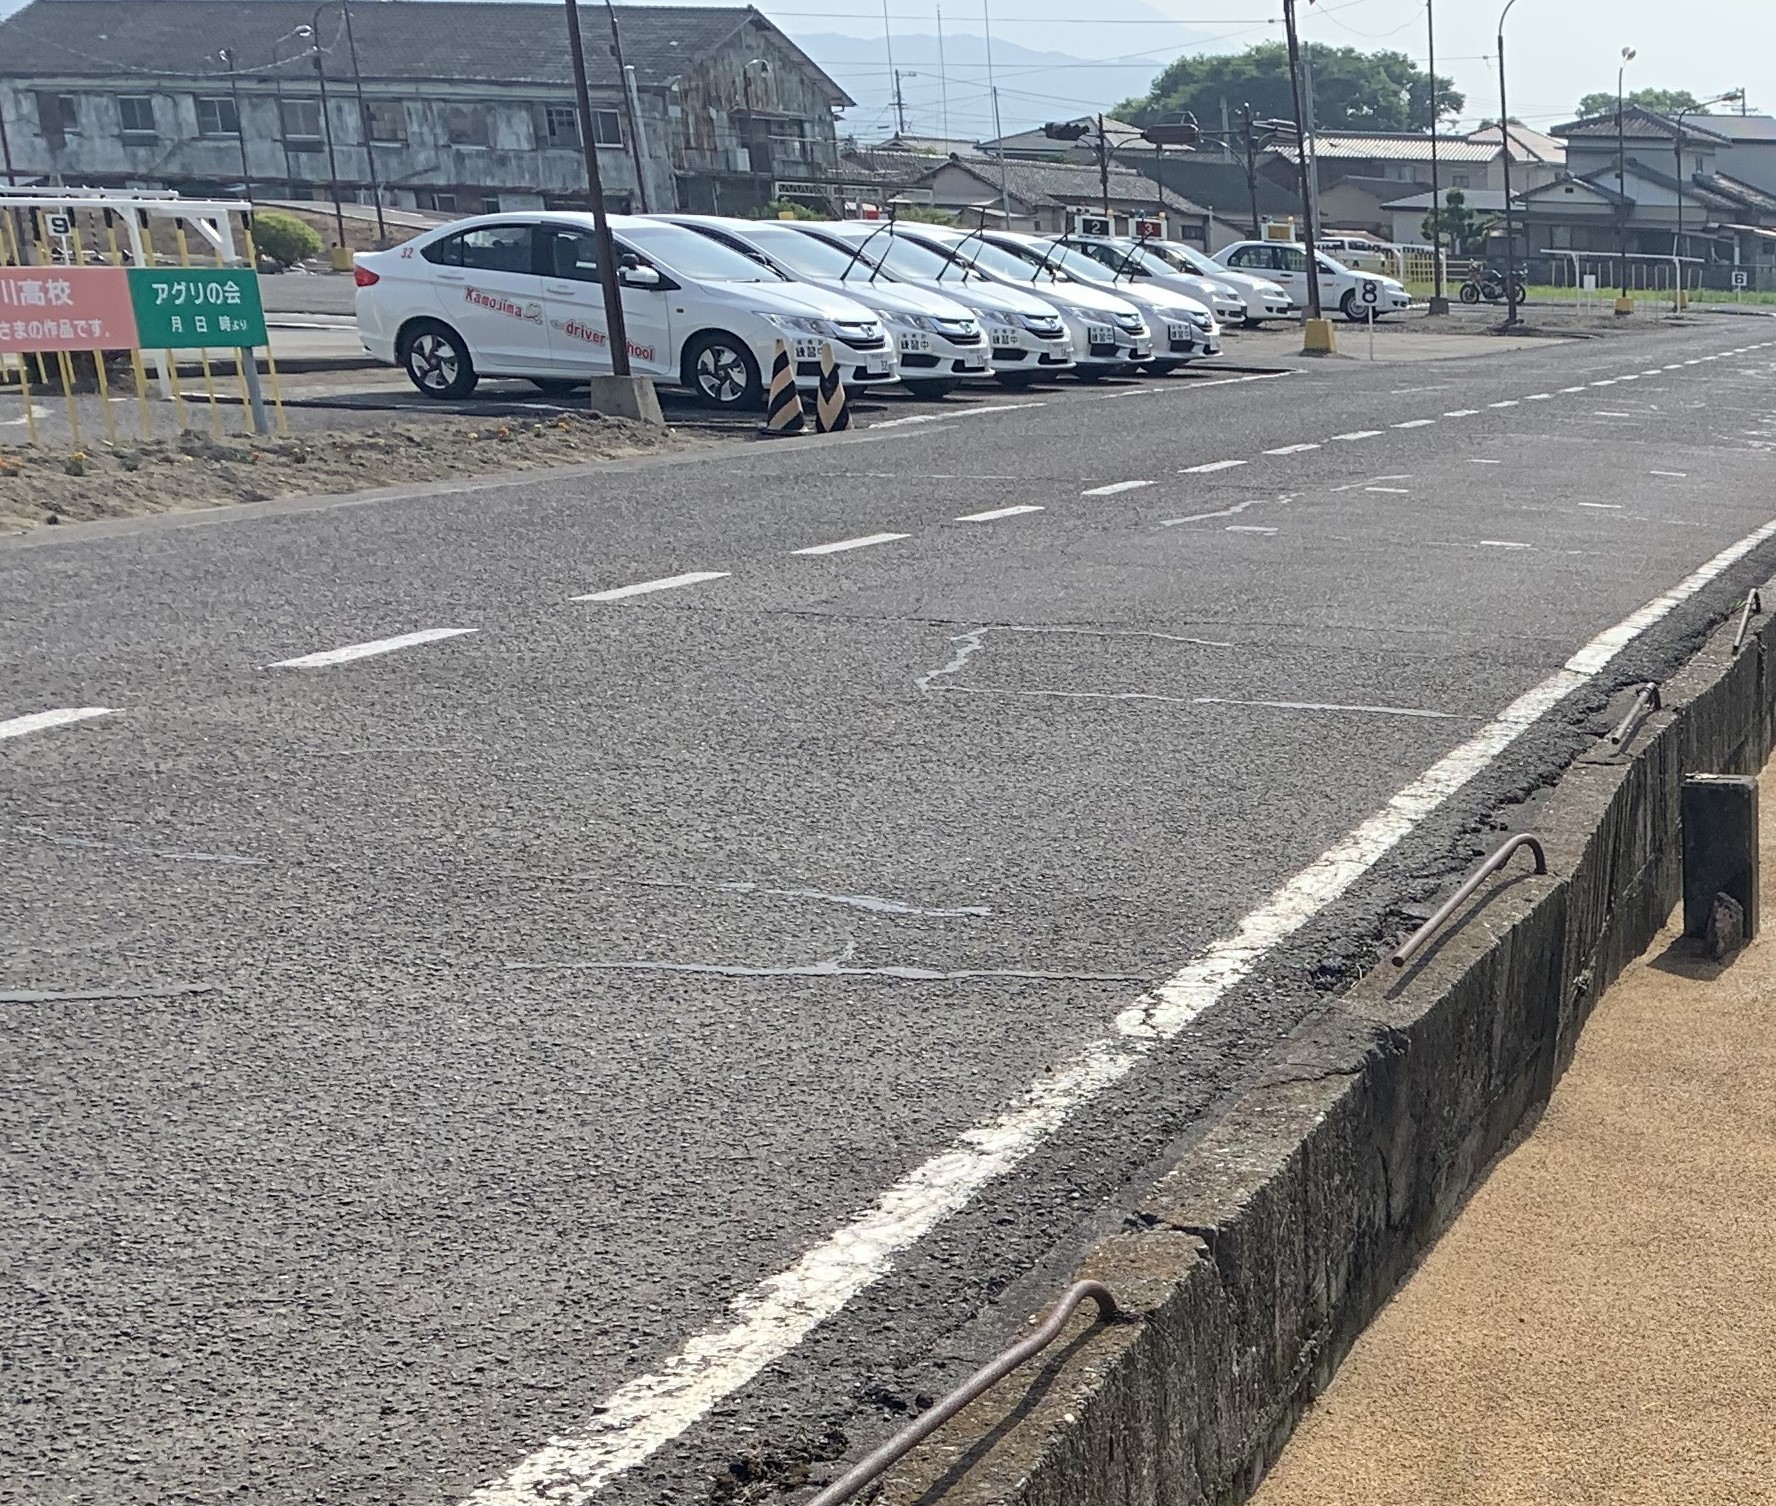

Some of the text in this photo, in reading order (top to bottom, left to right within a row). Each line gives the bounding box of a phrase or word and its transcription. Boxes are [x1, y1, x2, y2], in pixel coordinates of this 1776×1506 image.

[52, 217, 70, 234] 9
[1092, 221, 1100, 234] 2
[1145, 223, 1153, 235] 3
[401, 247, 414, 258] 32
[1735, 273, 1744, 284] 6
[152, 281, 241, 304] アグリの会
[1362, 281, 1377, 303] 8
[171, 316, 183, 332] 月
[195, 316, 208, 332] 日
[465, 286, 653, 361] Kamojima driver hool
